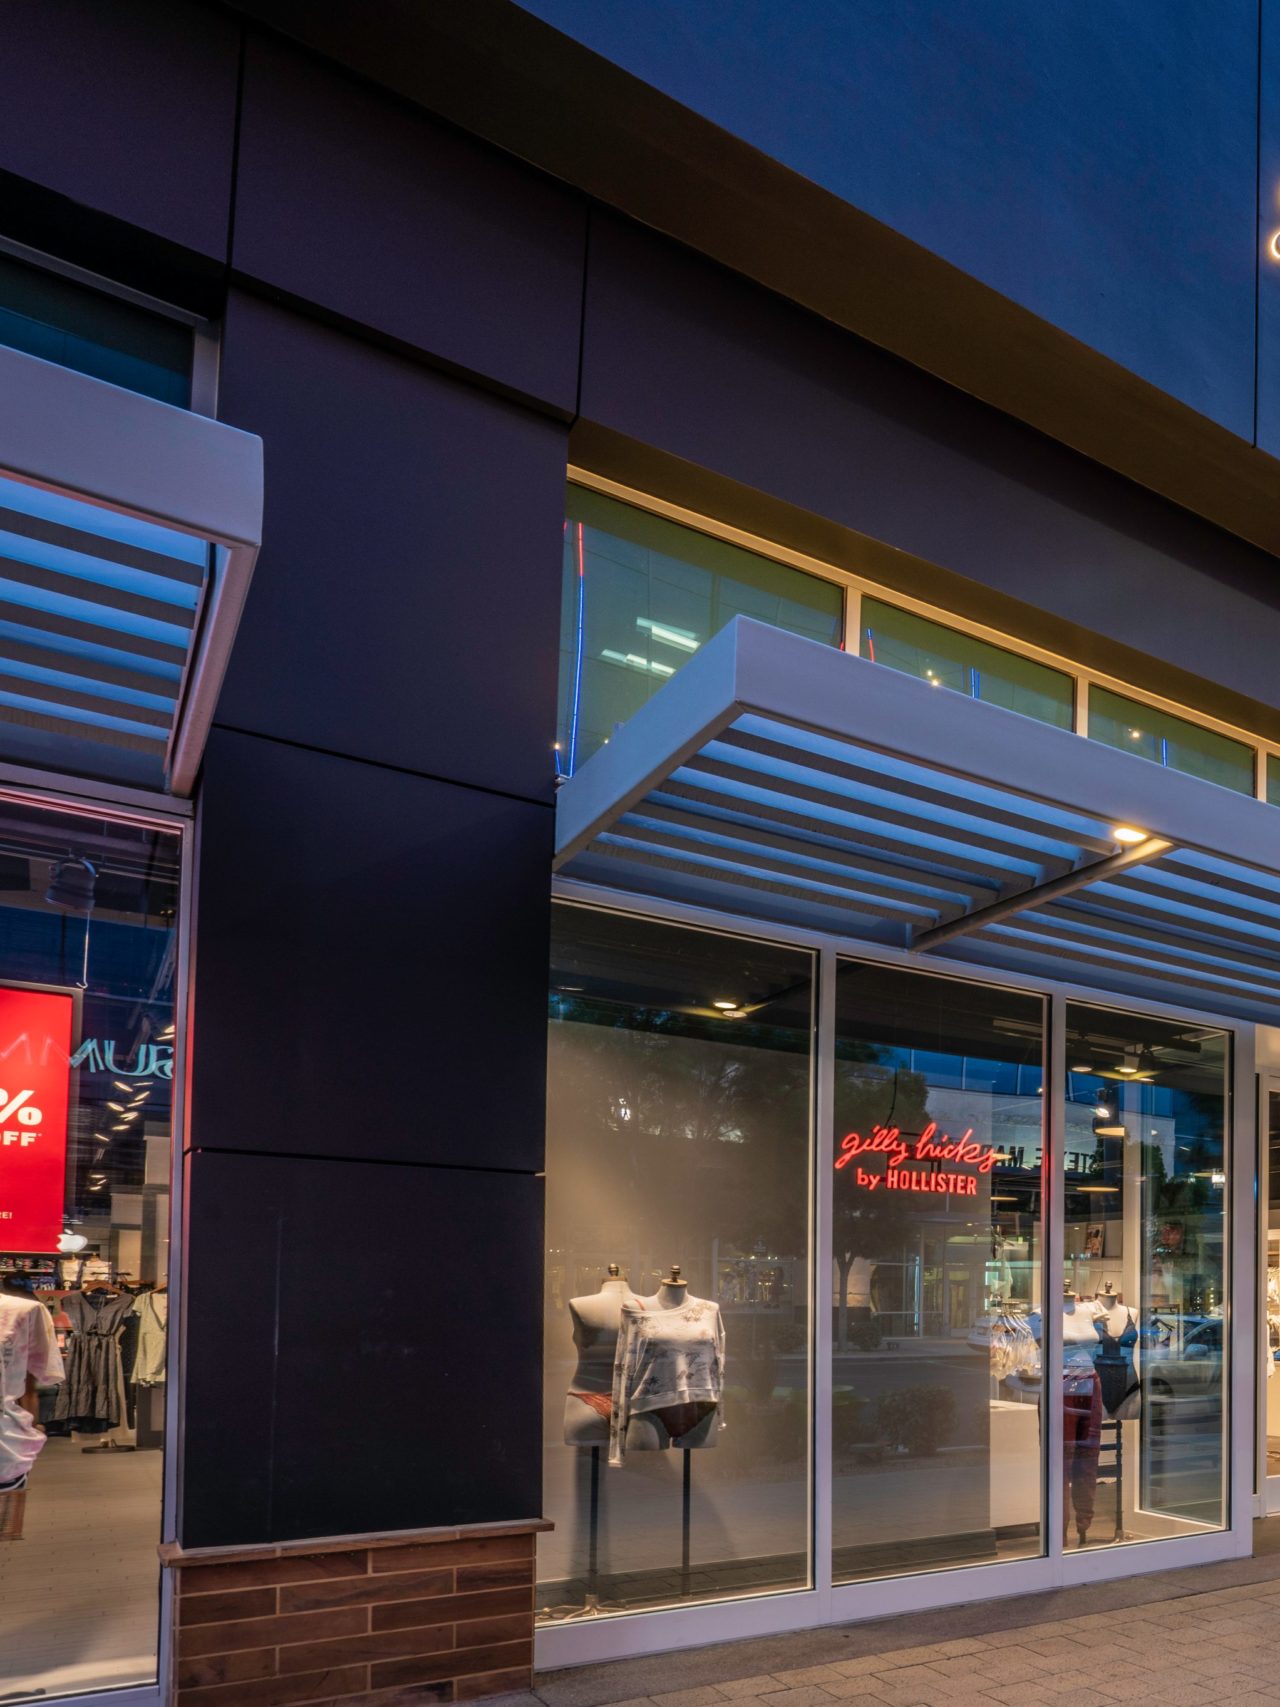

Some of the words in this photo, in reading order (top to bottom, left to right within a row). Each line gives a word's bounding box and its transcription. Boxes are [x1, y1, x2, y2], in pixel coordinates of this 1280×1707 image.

[834, 1124, 910, 1170] gilly
[916, 1122, 1001, 1173] hicks
[857, 1168, 880, 1190] by
[886, 1170, 977, 1196] HOLLISTER
